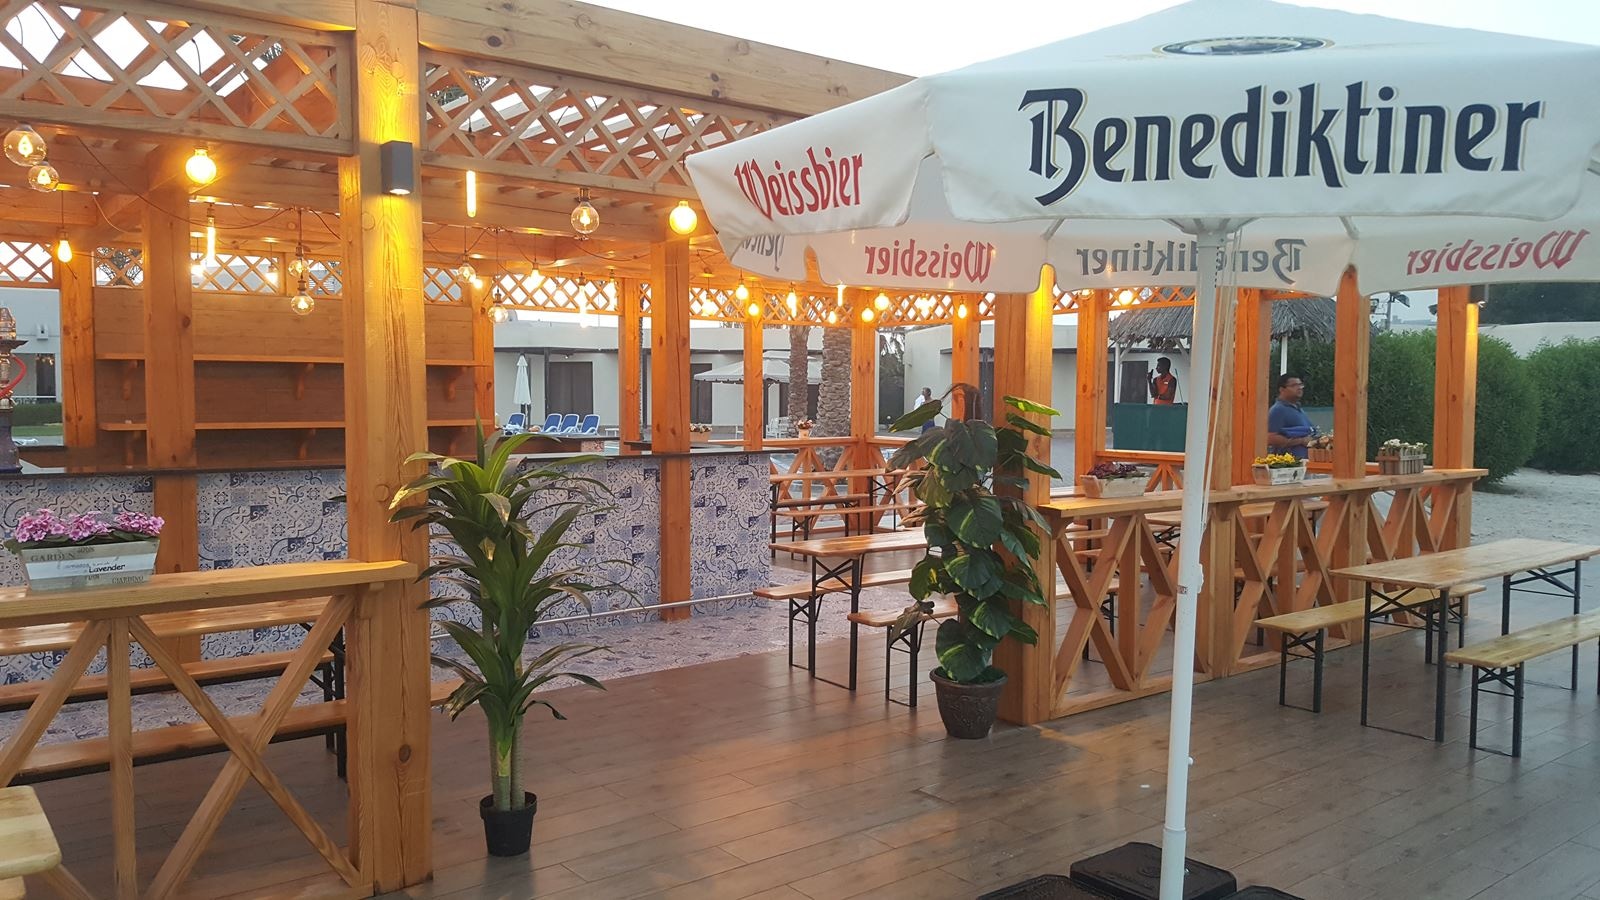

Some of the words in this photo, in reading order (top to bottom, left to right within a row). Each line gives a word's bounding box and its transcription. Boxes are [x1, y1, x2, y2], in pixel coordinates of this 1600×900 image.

[1018, 80, 1545, 207] Benediktiner
[734, 146, 863, 221] Weissbier
[88, 563, 126, 573] Lavender
